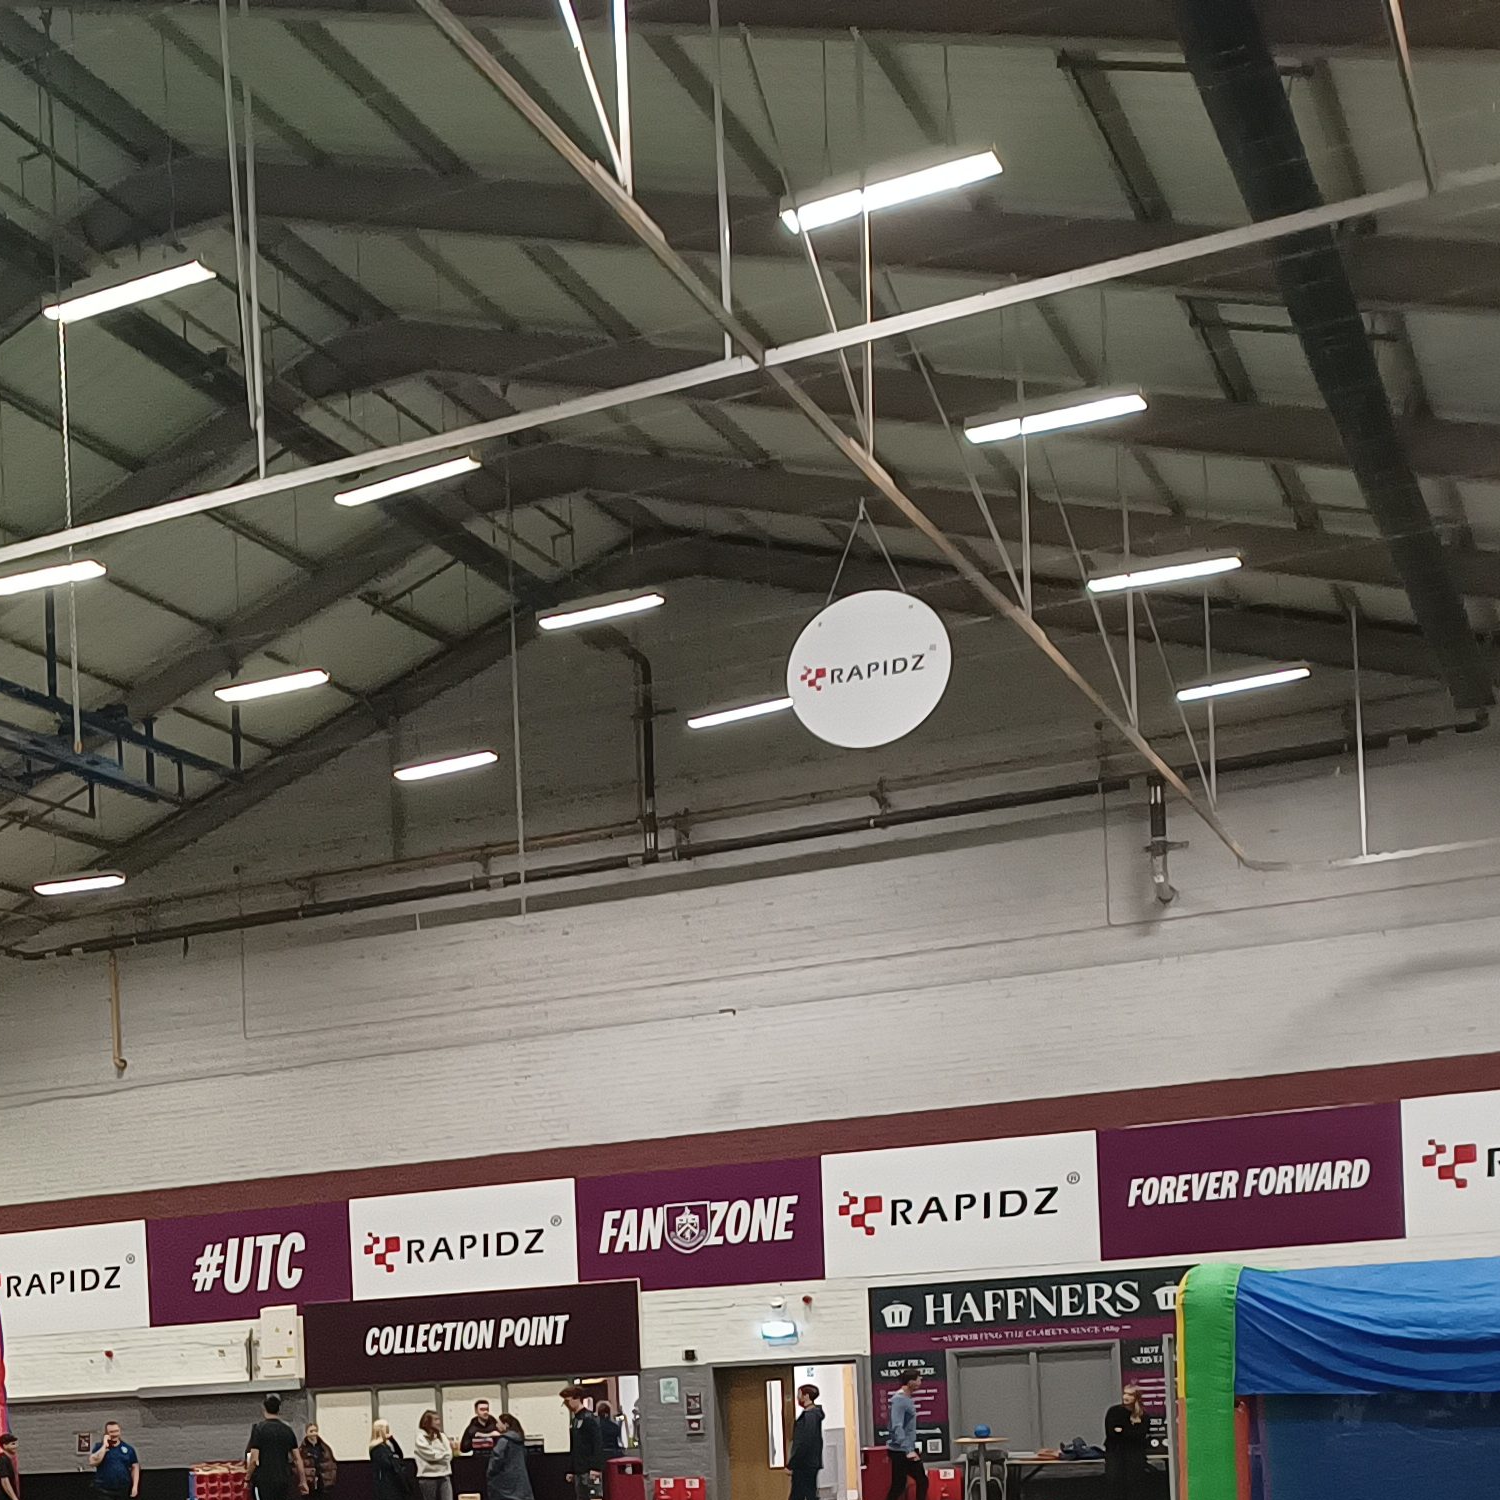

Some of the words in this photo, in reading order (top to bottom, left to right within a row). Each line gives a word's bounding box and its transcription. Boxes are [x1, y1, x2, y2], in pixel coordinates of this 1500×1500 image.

[830, 653, 925, 685] RAPIDZ
[1127, 1169, 1238, 1208] FOREVER
[1243, 1158, 1371, 1199] FORWARD
[598, 1204, 665, 1254] FAN
[706, 1194, 799, 1246] ZONE
[889, 1186, 1059, 1226] RAPIDZ
[191, 1231, 307, 1292] #UTC
[406, 1228, 545, 1264] RAPIDZ
[5, 1265, 122, 1299] RAPIDZ
[924, 1280, 1141, 1326] HAFFNERS
[365, 1320, 495, 1357] COLLECTION
[498, 1314, 570, 1349] POINT
